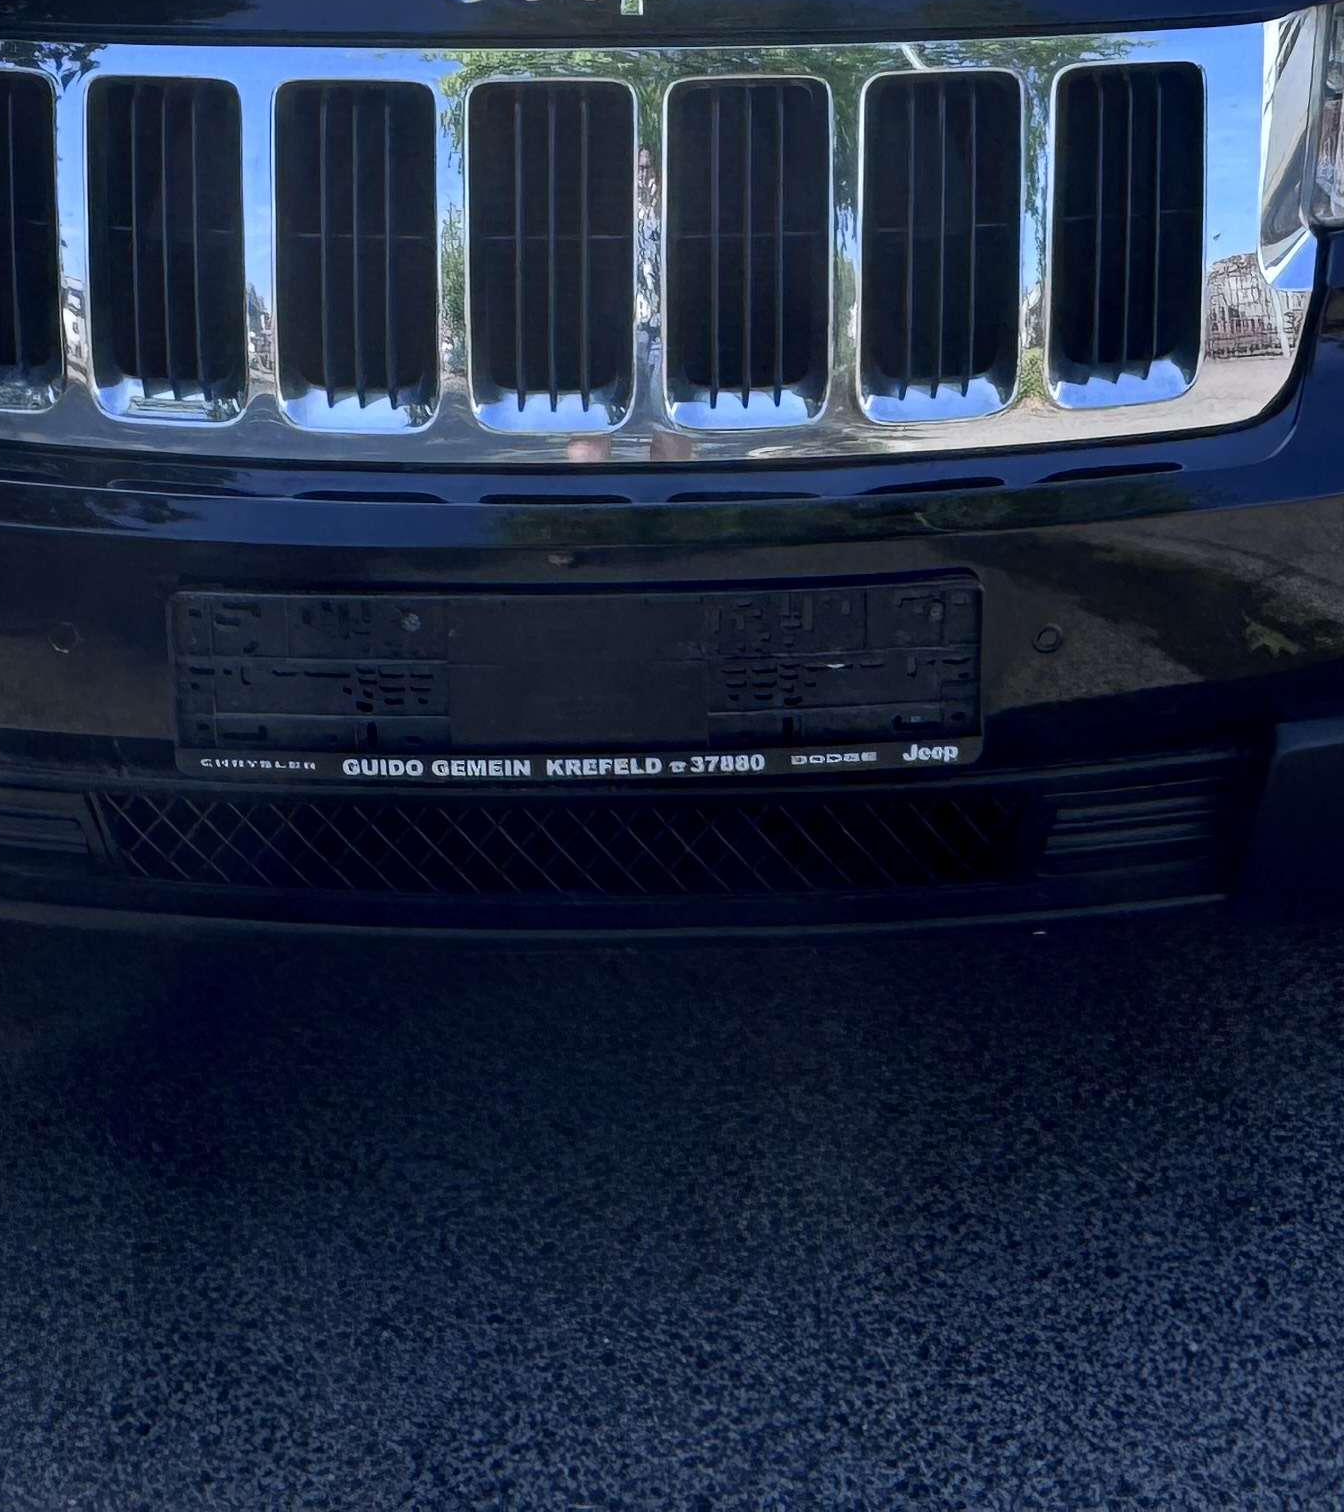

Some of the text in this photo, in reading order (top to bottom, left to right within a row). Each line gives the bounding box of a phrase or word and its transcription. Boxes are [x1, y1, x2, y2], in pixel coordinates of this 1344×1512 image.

[342, 757, 425, 777] GUIDO
[431, 758, 532, 778] GEMEIN
[546, 756, 663, 777] KREFELD
[901, 743, 960, 763] Jeep
